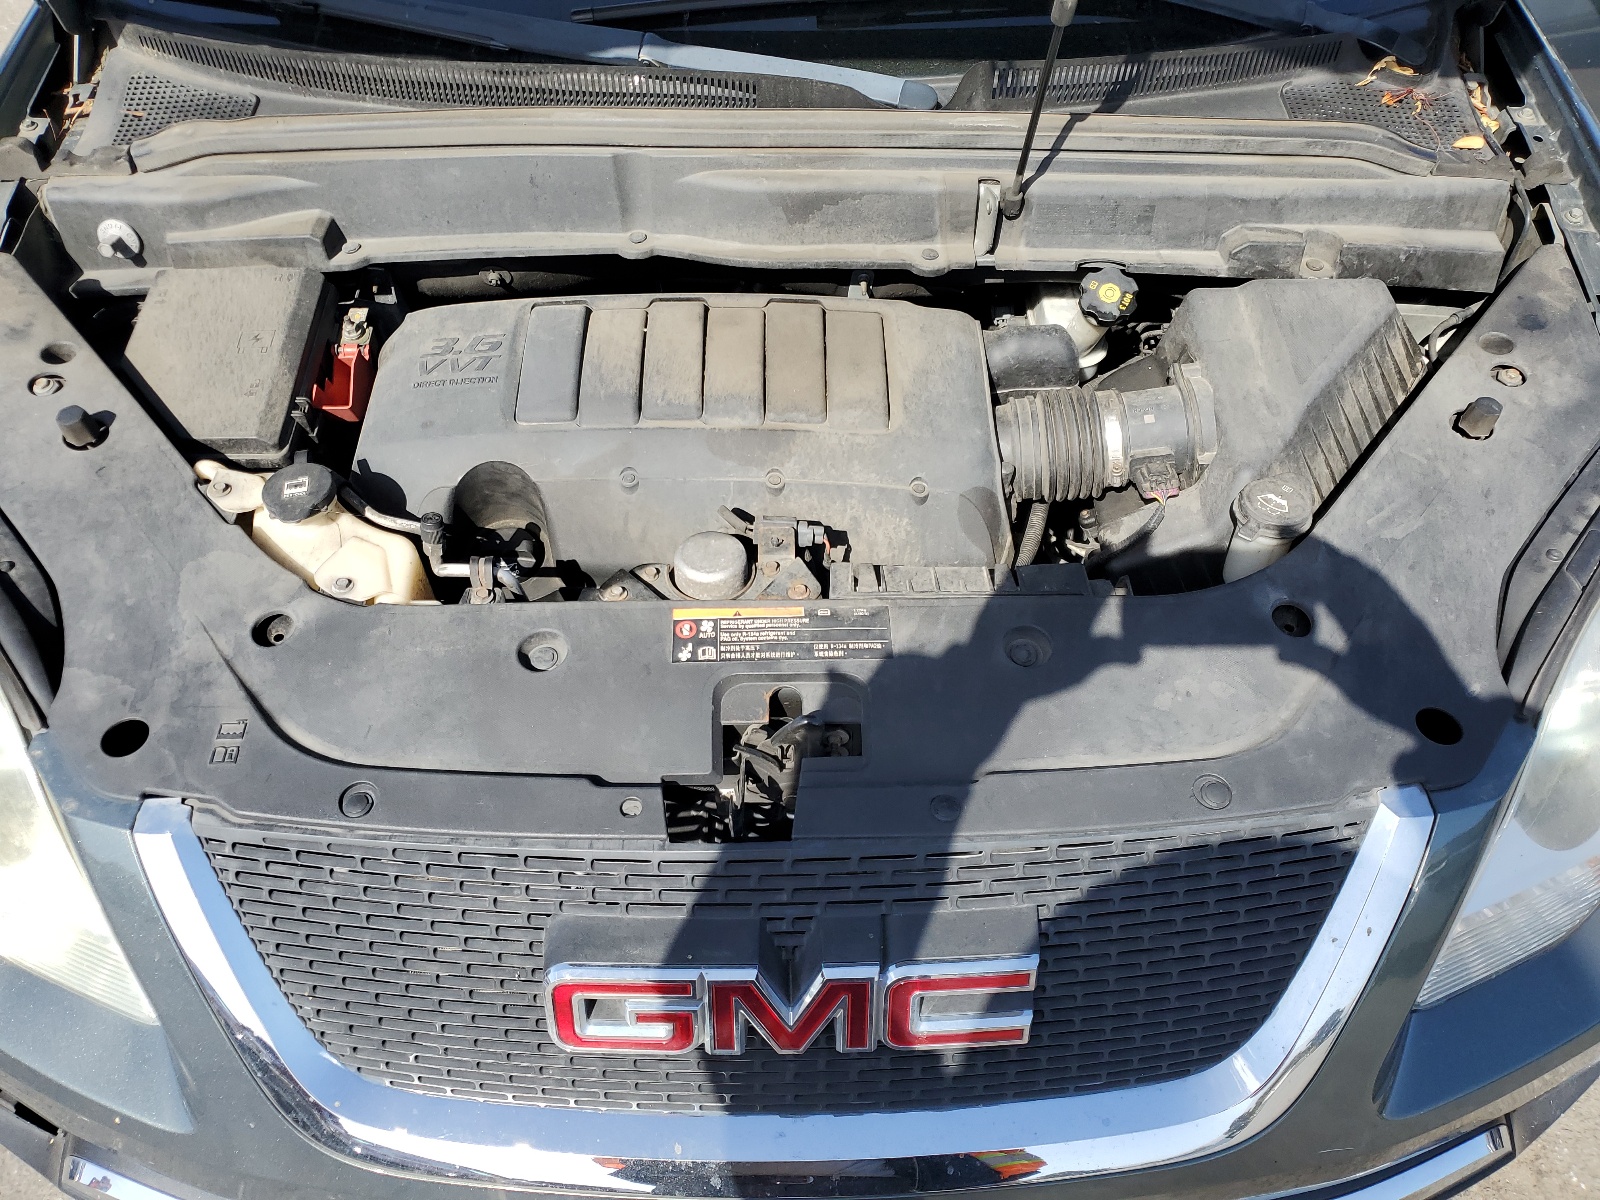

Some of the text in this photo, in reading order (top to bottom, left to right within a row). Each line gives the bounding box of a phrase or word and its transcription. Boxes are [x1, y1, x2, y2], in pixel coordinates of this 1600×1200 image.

[1121, 293, 1133, 306] DOT
[420, 333, 506, 358] 3.6
[418, 355, 502, 376] VVT
[413, 376, 499, 389] DIRECT INJECTION
[699, 631, 716, 639] AUTO
[545, 956, 1040, 1055] GMC
